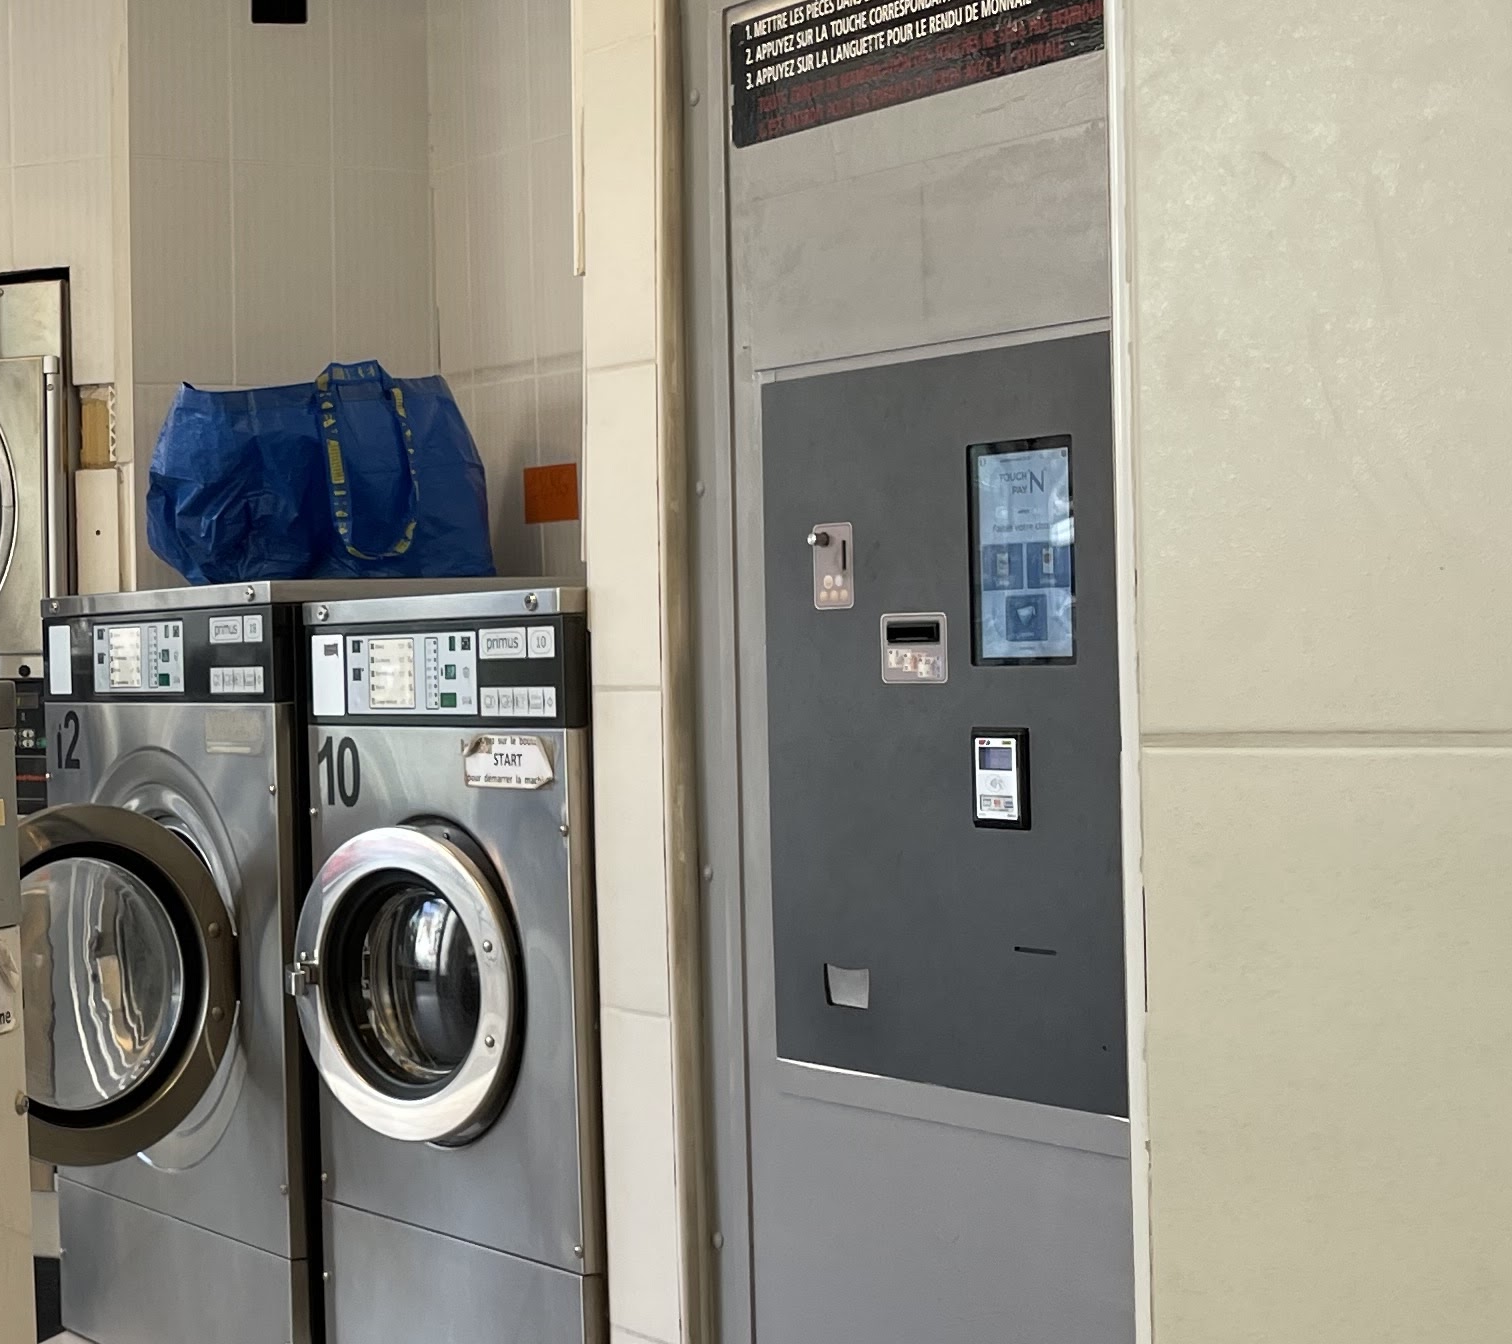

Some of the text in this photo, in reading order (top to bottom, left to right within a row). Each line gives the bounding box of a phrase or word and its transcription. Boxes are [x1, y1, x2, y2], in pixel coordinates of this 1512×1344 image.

[745, 24, 753, 40] 1.
[754, 11, 788, 38] METTRE
[789, 6, 805, 25] LES
[745, 48, 754, 65] 2.
[755, 34, 795, 63] APPUYEZ
[796, 30, 814, 49] SUR
[815, 25, 829, 43] LA
[830, 11, 867, 36] TOUCHE
[745, 72, 754, 90] 3.
[755, 59, 796, 87] APPUYEZ
[797, 54, 814, 74] SUR
[815, 49, 829, 68] LA
[830, 31, 885, 63] LANGUETTE
[887, 20, 914, 47] POUR
[916, 17, 927, 38] LE
[929, 7, 963, 33] RENDU
[965, 2, 979, 23] DE
[1011, 485, 1028, 495] PAY
[214, 623, 238, 638] primus
[486, 635, 519, 650] primus
[537, 635, 547, 648] 10
[493, 753, 522, 767] START
[317, 735, 361, 808] 10
